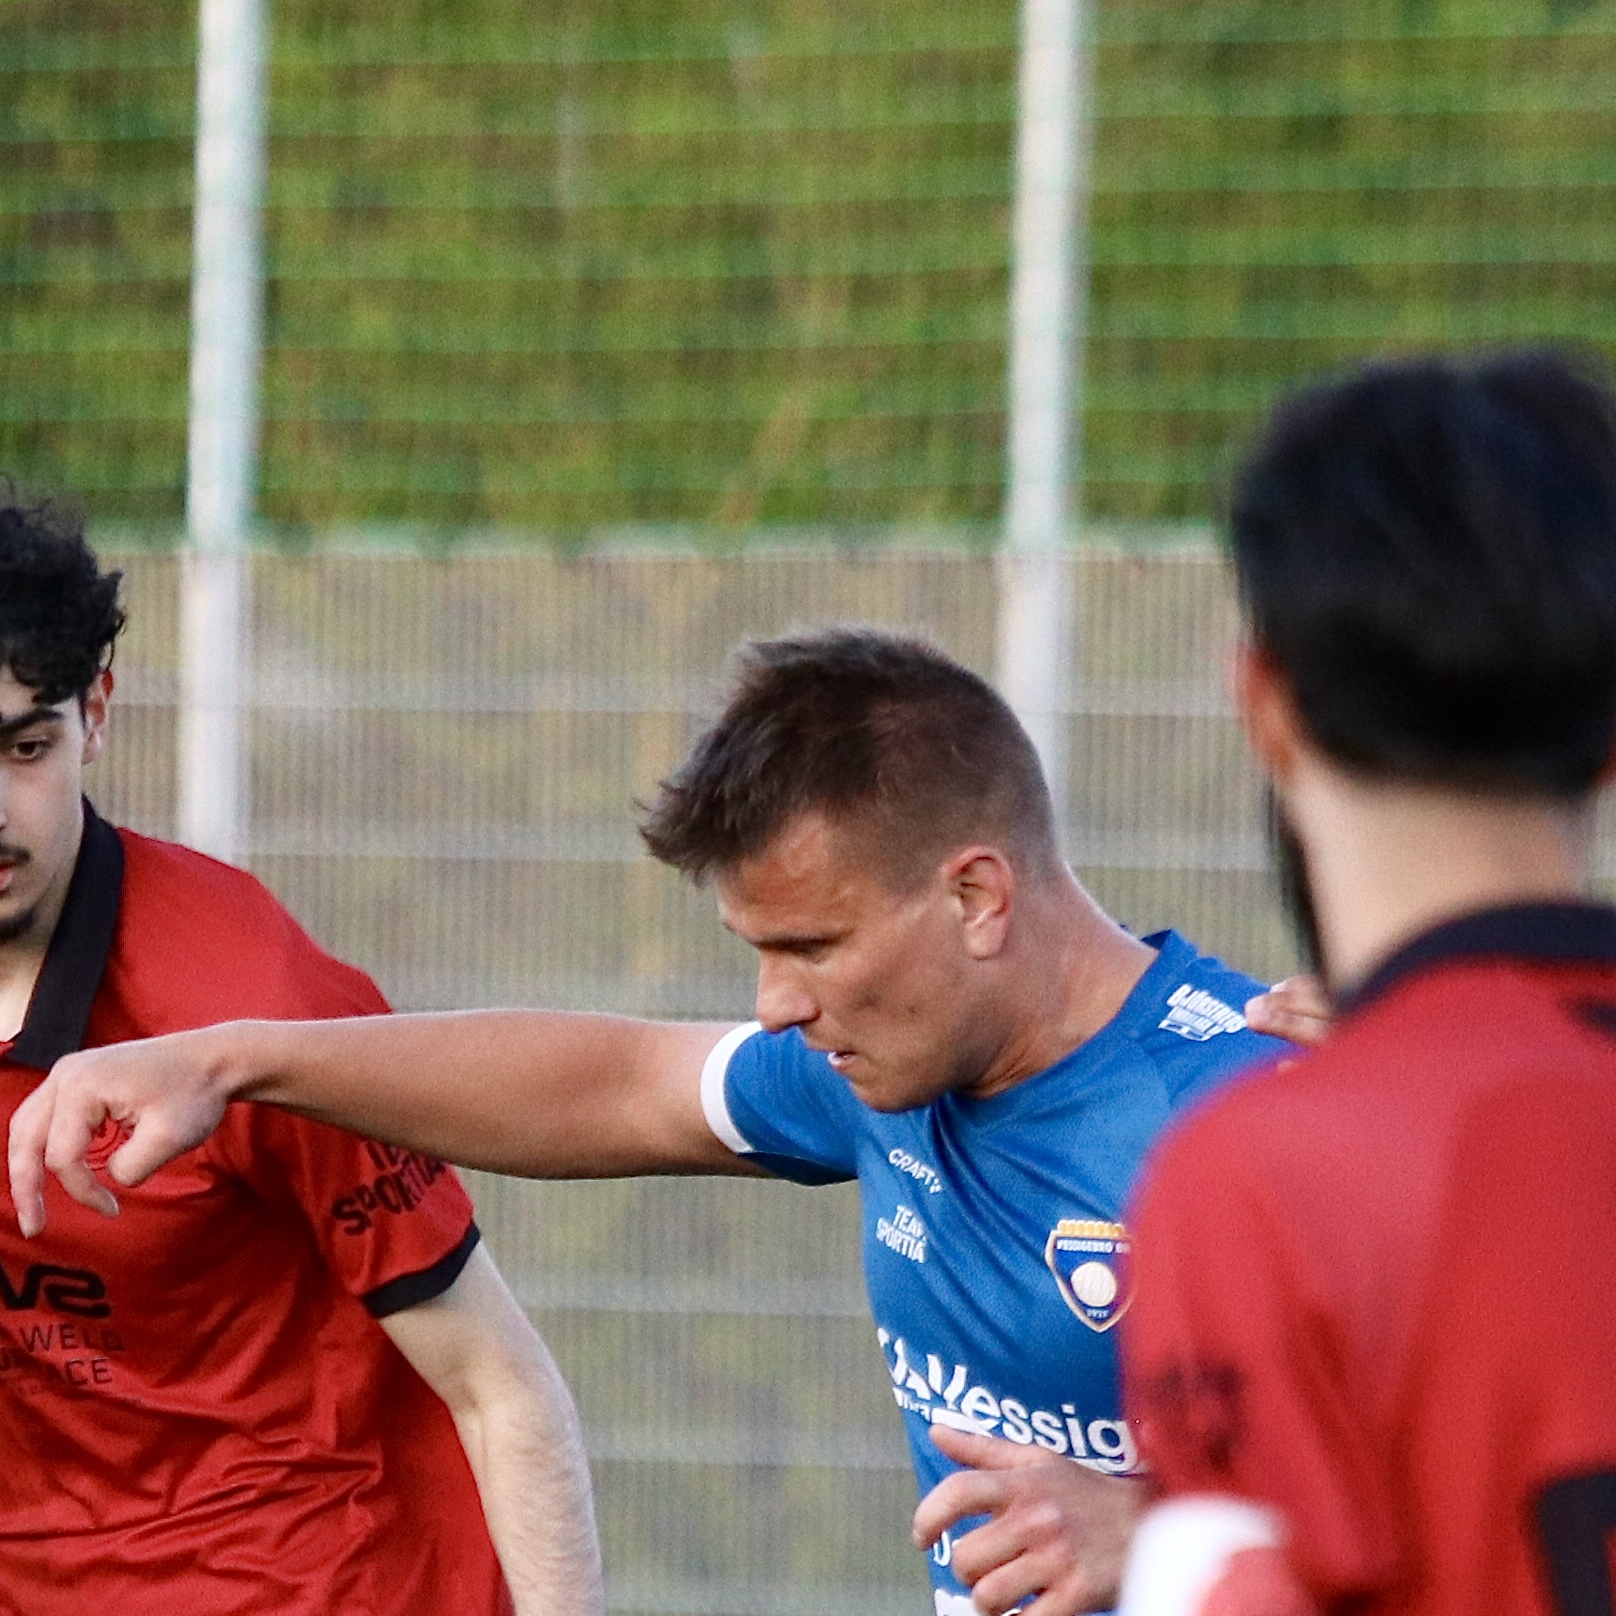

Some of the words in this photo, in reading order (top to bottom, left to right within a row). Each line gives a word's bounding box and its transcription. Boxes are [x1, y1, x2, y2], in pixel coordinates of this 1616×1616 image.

[887, 1148, 936, 1186] CRAFT
[876, 1218, 927, 1263] SPORTIA
[19, 1322, 125, 1354] WELD
[926, 1354, 1140, 1473] Vessig
